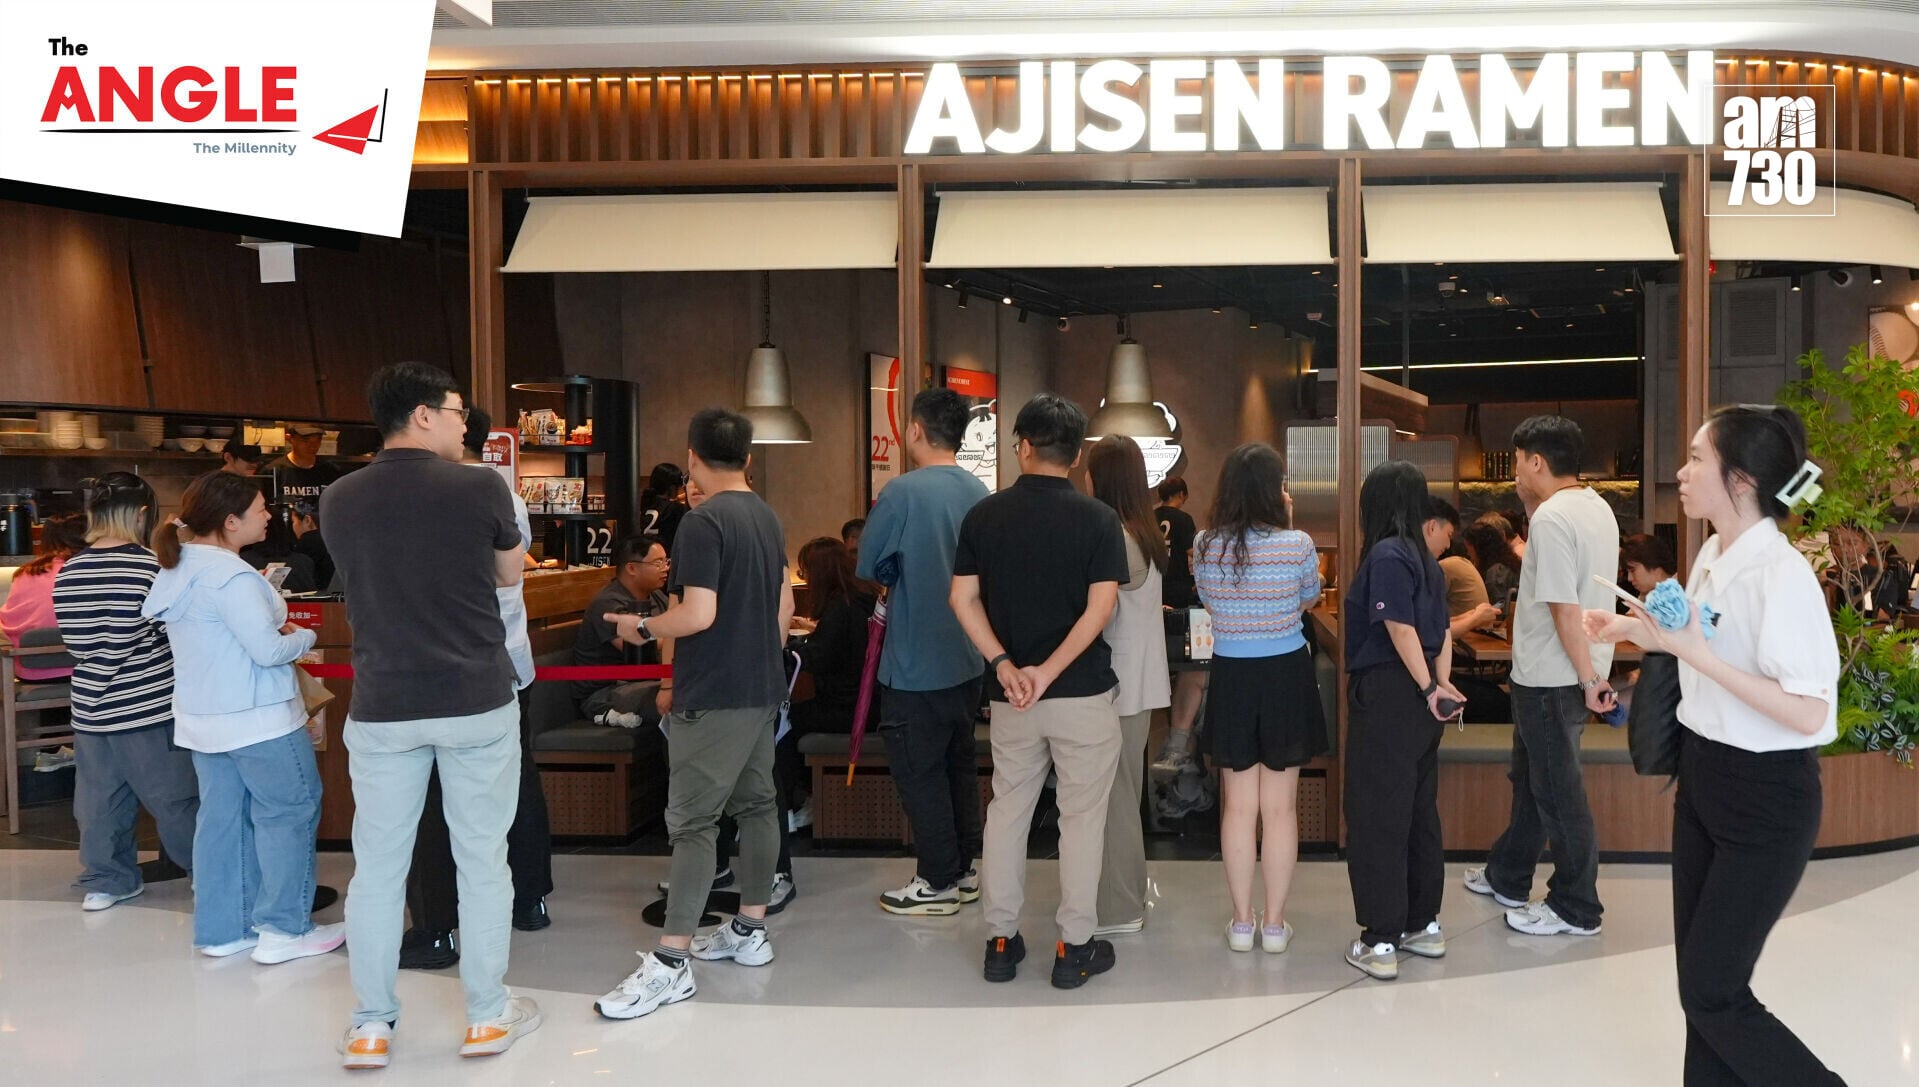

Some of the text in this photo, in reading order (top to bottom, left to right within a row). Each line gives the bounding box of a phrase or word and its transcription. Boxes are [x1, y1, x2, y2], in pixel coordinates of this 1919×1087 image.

[904, 50, 1714, 154] AJISEN RAMEN
[587, 527, 612, 554] 22
